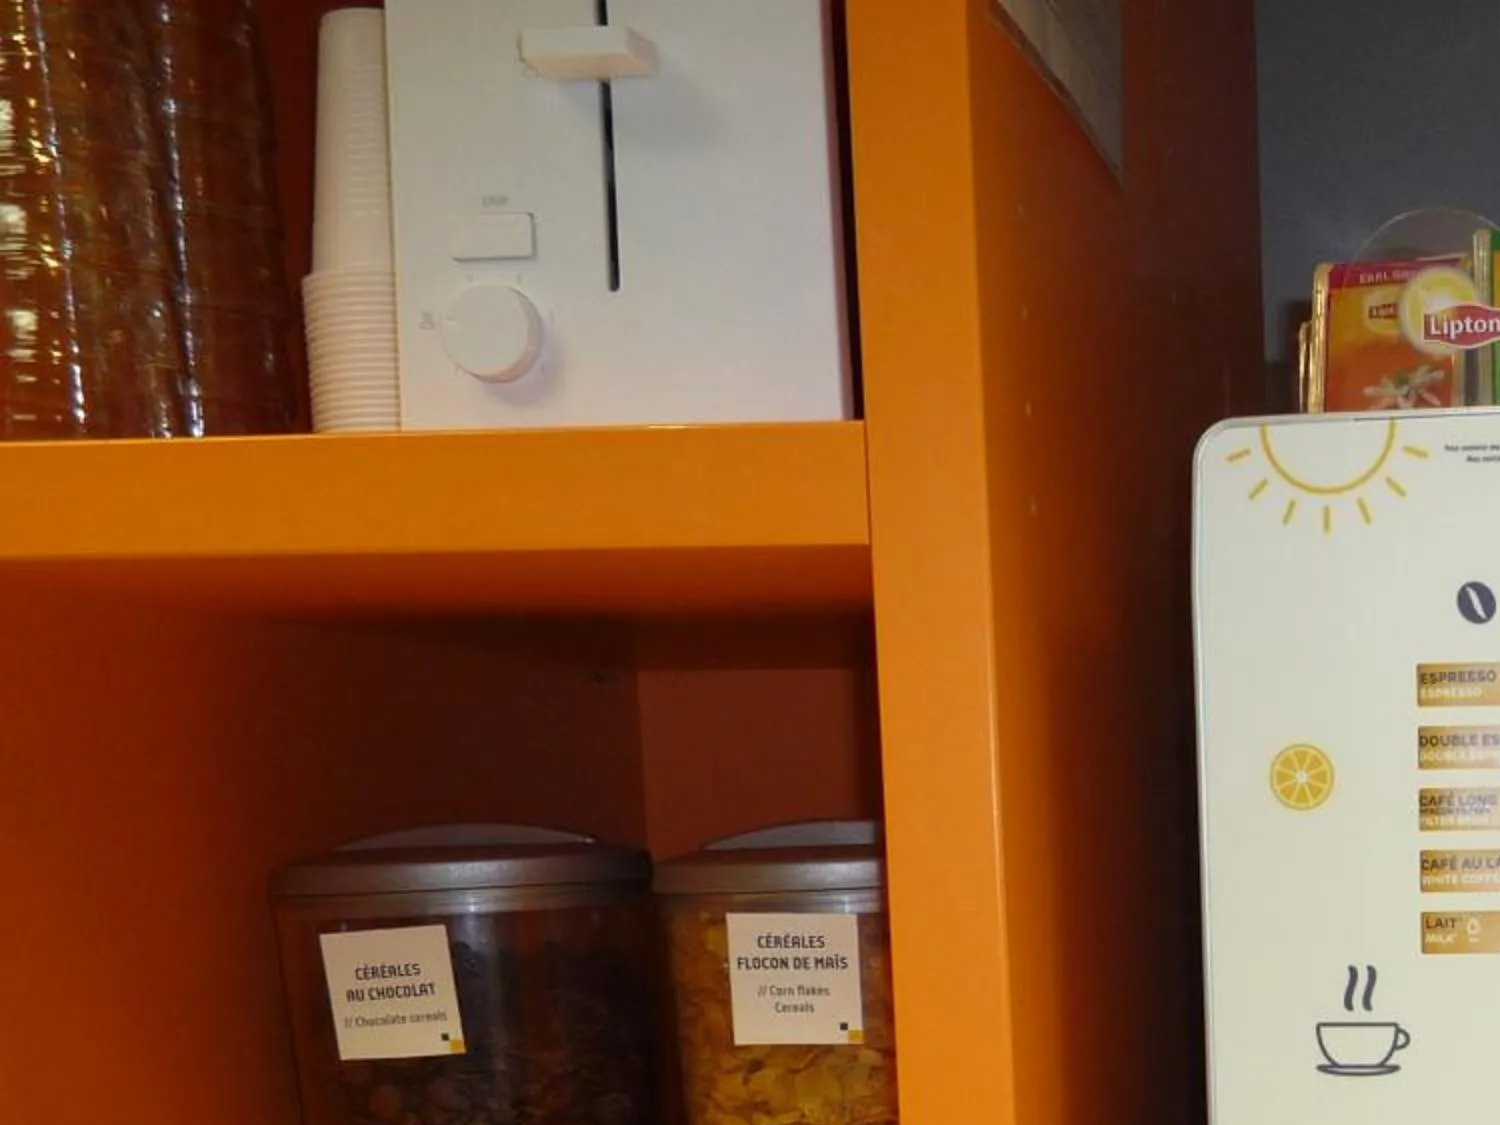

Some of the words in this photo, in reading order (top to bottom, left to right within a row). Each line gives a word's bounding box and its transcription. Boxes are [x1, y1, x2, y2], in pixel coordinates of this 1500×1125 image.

[1419, 670, 1497, 684] ESPRESSO
[1419, 734, 1478, 748] DOUBLE
[1419, 791, 1455, 806] CAFÉ
[1421, 855, 1457, 871] CAFÉ
[1461, 857, 1482, 869] AU
[757, 932, 826, 949] CÉRÉALES
[737, 957, 789, 971] FLOCON
[793, 957, 811, 970] DE
[815, 954, 848, 971] MAÏS
[355, 963, 421, 981] CÉRÉALES
[346, 989, 365, 1002] AU
[368, 982, 436, 1001] CHOCOLAT
[769, 985, 795, 997] Corn
[775, 1002, 815, 1014] Cereals
[355, 1014, 407, 1028] Chocolate
[410, 1009, 448, 1023] cereals
